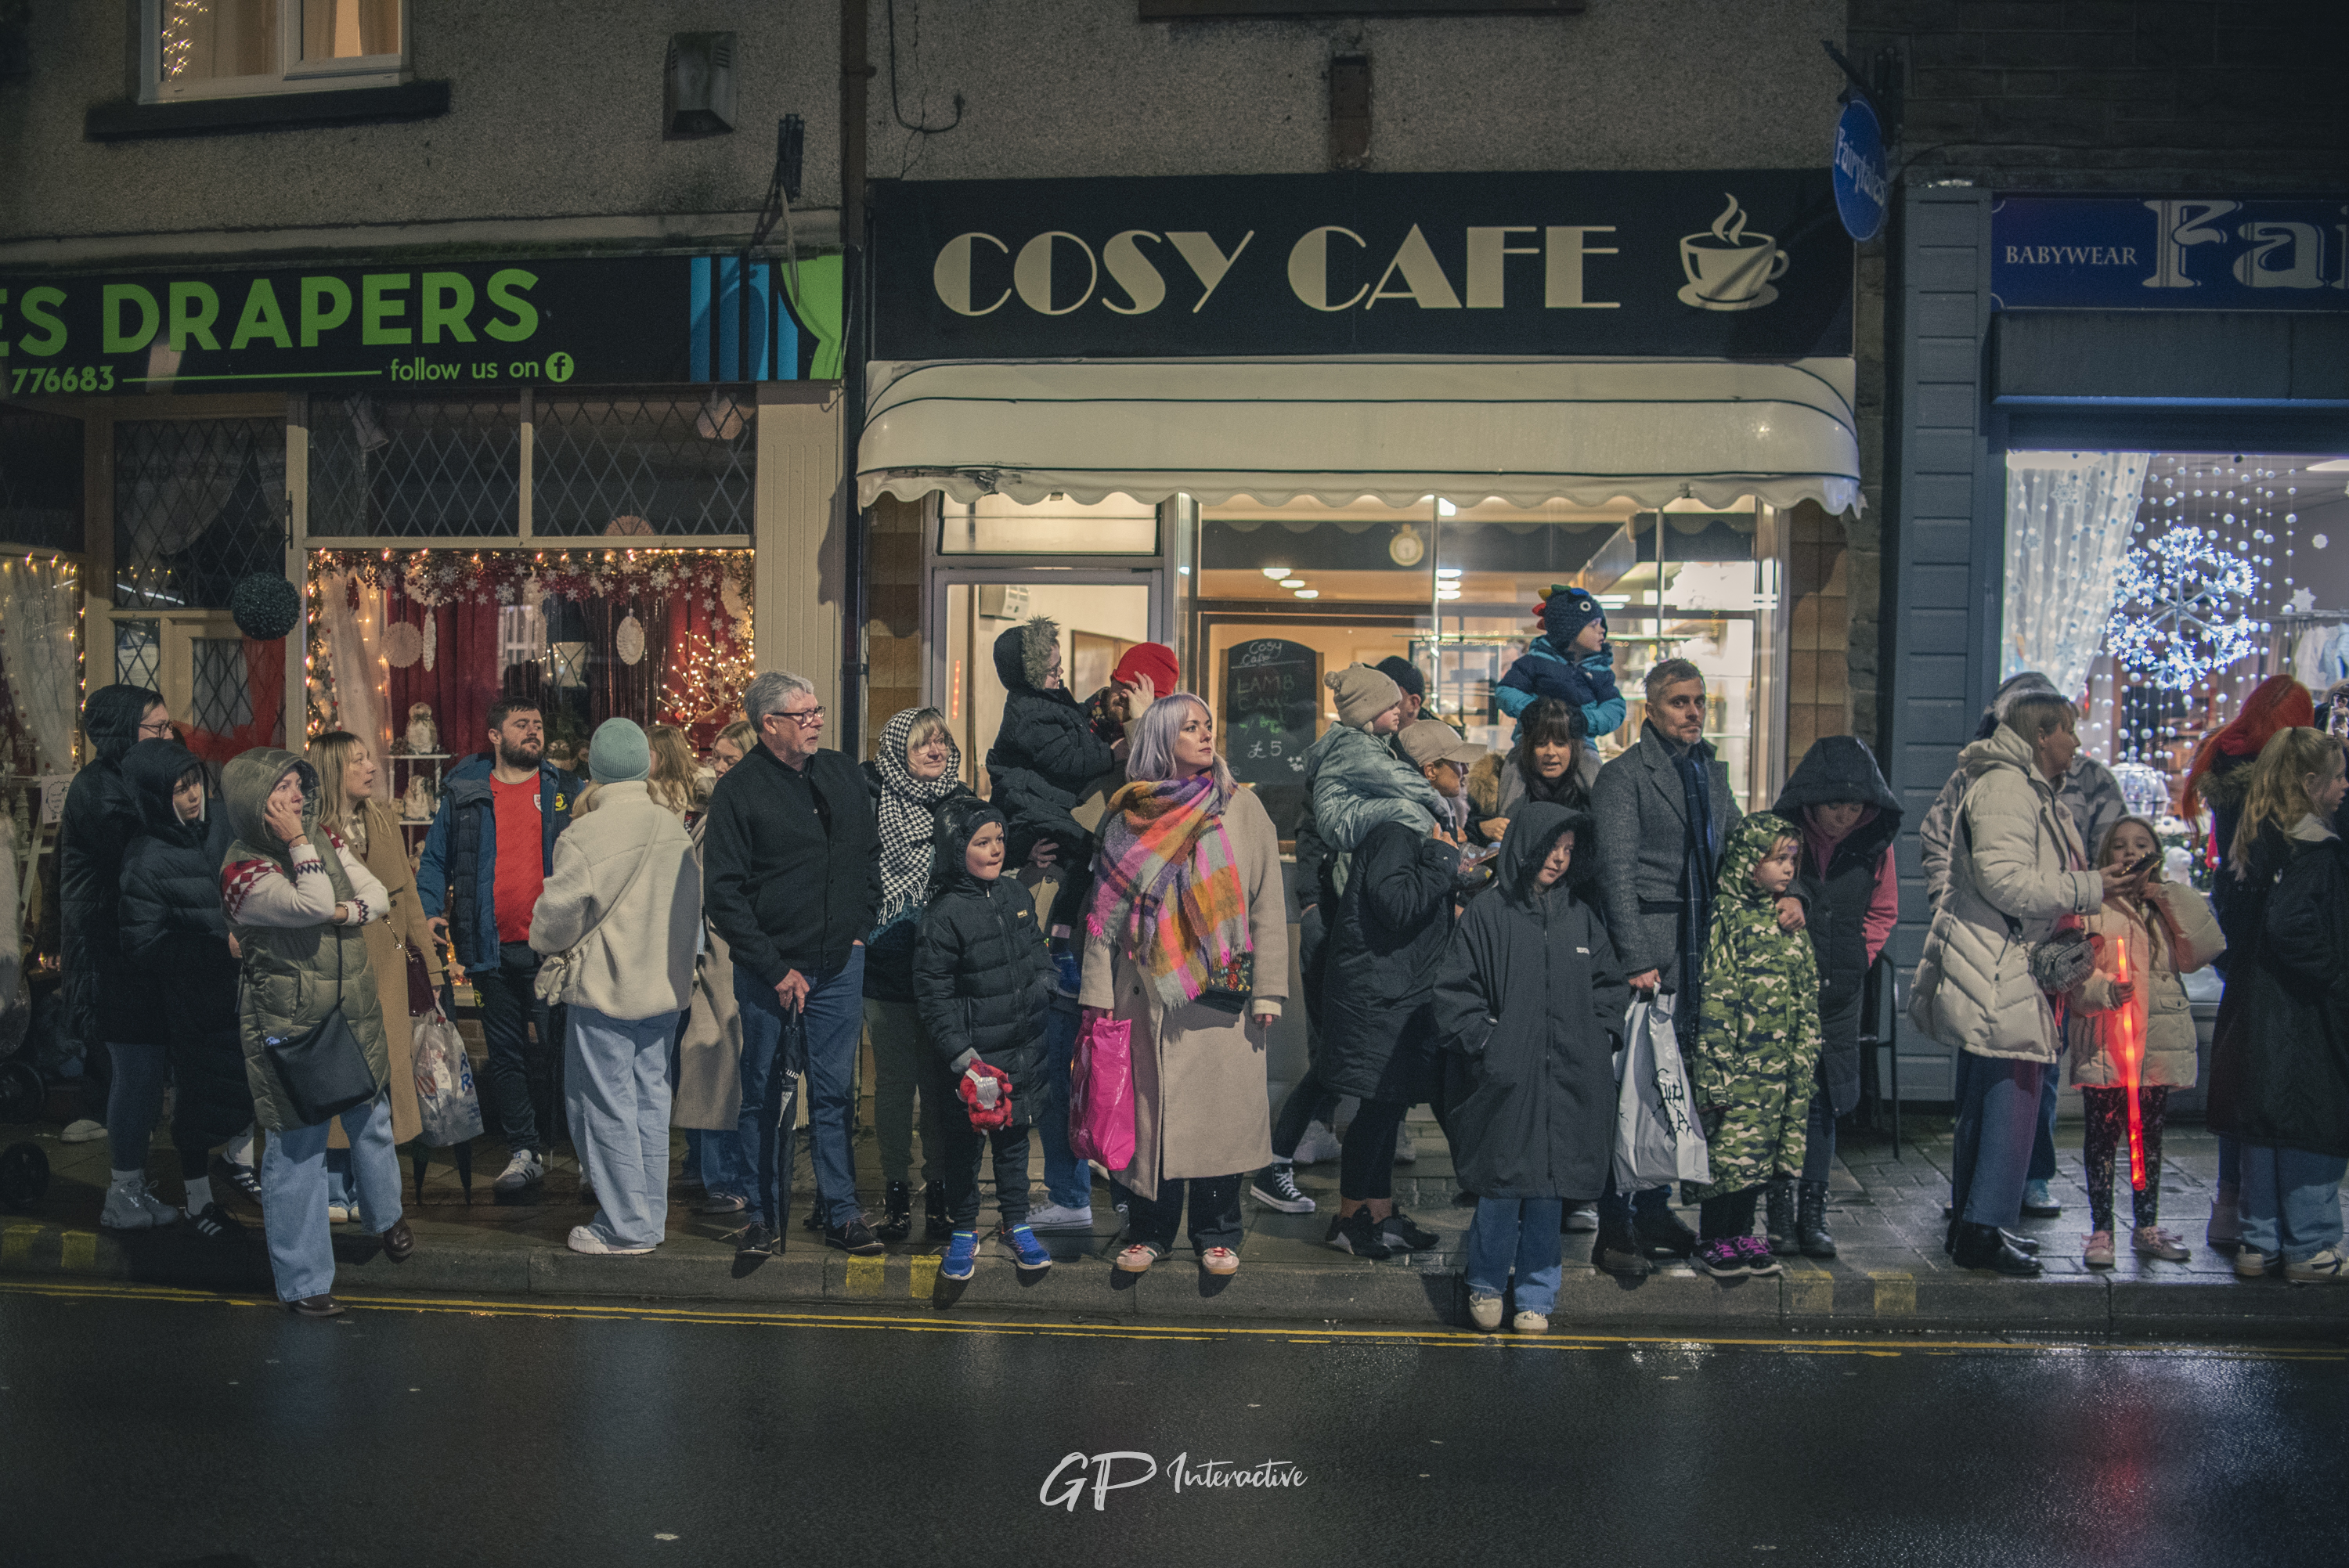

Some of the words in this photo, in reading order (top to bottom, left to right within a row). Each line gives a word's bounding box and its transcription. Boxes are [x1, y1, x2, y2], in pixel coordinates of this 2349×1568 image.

[933, 230, 1254, 315] COSY
[1287, 222, 1621, 312] CAFE
[2005, 245, 2138, 266] BABYWEAR
[0, 286, 67, 356] S
[103, 269, 539, 354] DRAPERS
[12, 366, 114, 394] 776683
[391, 357, 461, 381] follow
[472, 362, 498, 379] us
[510, 361, 539, 378] on
